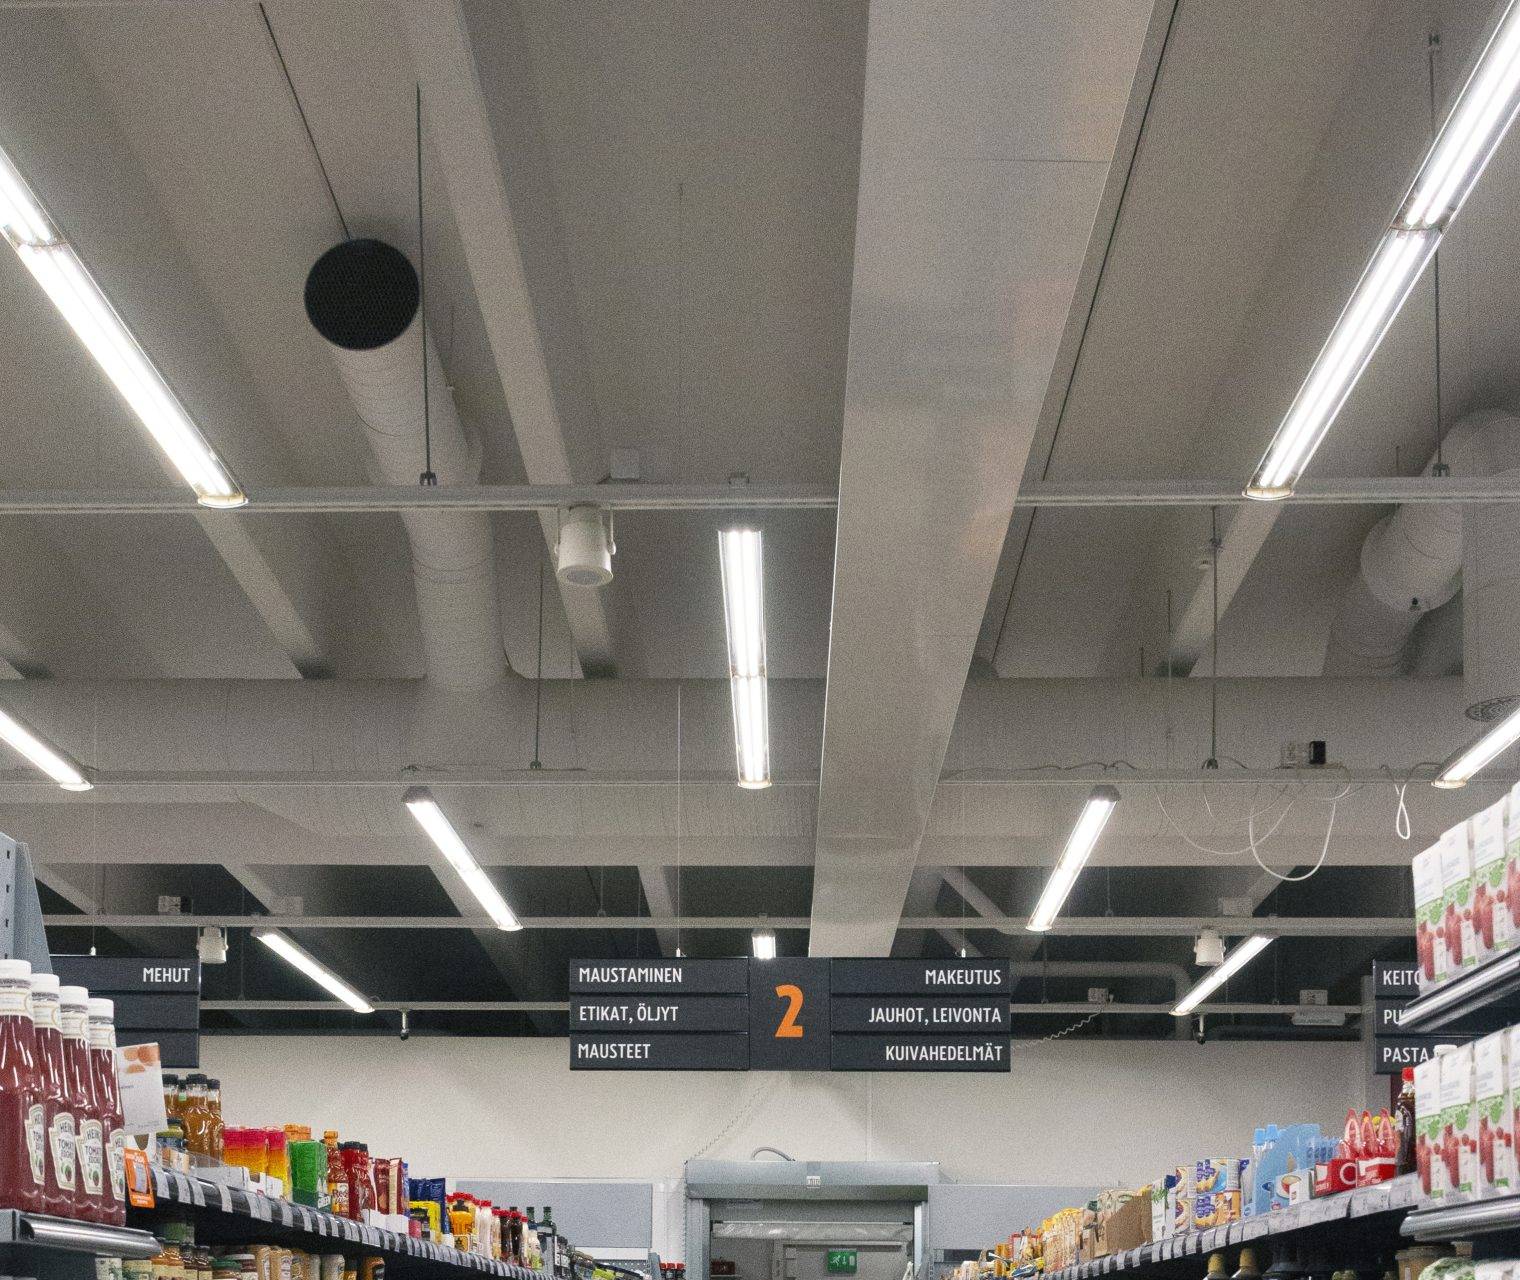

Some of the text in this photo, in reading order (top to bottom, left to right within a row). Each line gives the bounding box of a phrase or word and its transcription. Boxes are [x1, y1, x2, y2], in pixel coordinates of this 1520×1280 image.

[142, 967, 191, 983] MEHUT
[578, 967, 683, 984] MAUSTAMINEN
[925, 969, 1002, 985] MAKEUTUS
[579, 1002, 679, 1024] ETIKAT, ÖLJYT
[774, 984, 804, 1038] 2
[868, 1007, 1002, 1026] JAUHOT, LEIVONTA
[577, 1043, 651, 1059] MAUSTEET
[885, 1042, 1003, 1062] KUIVAHEDELMÄT
[1382, 1046, 1429, 1063] PASTA
